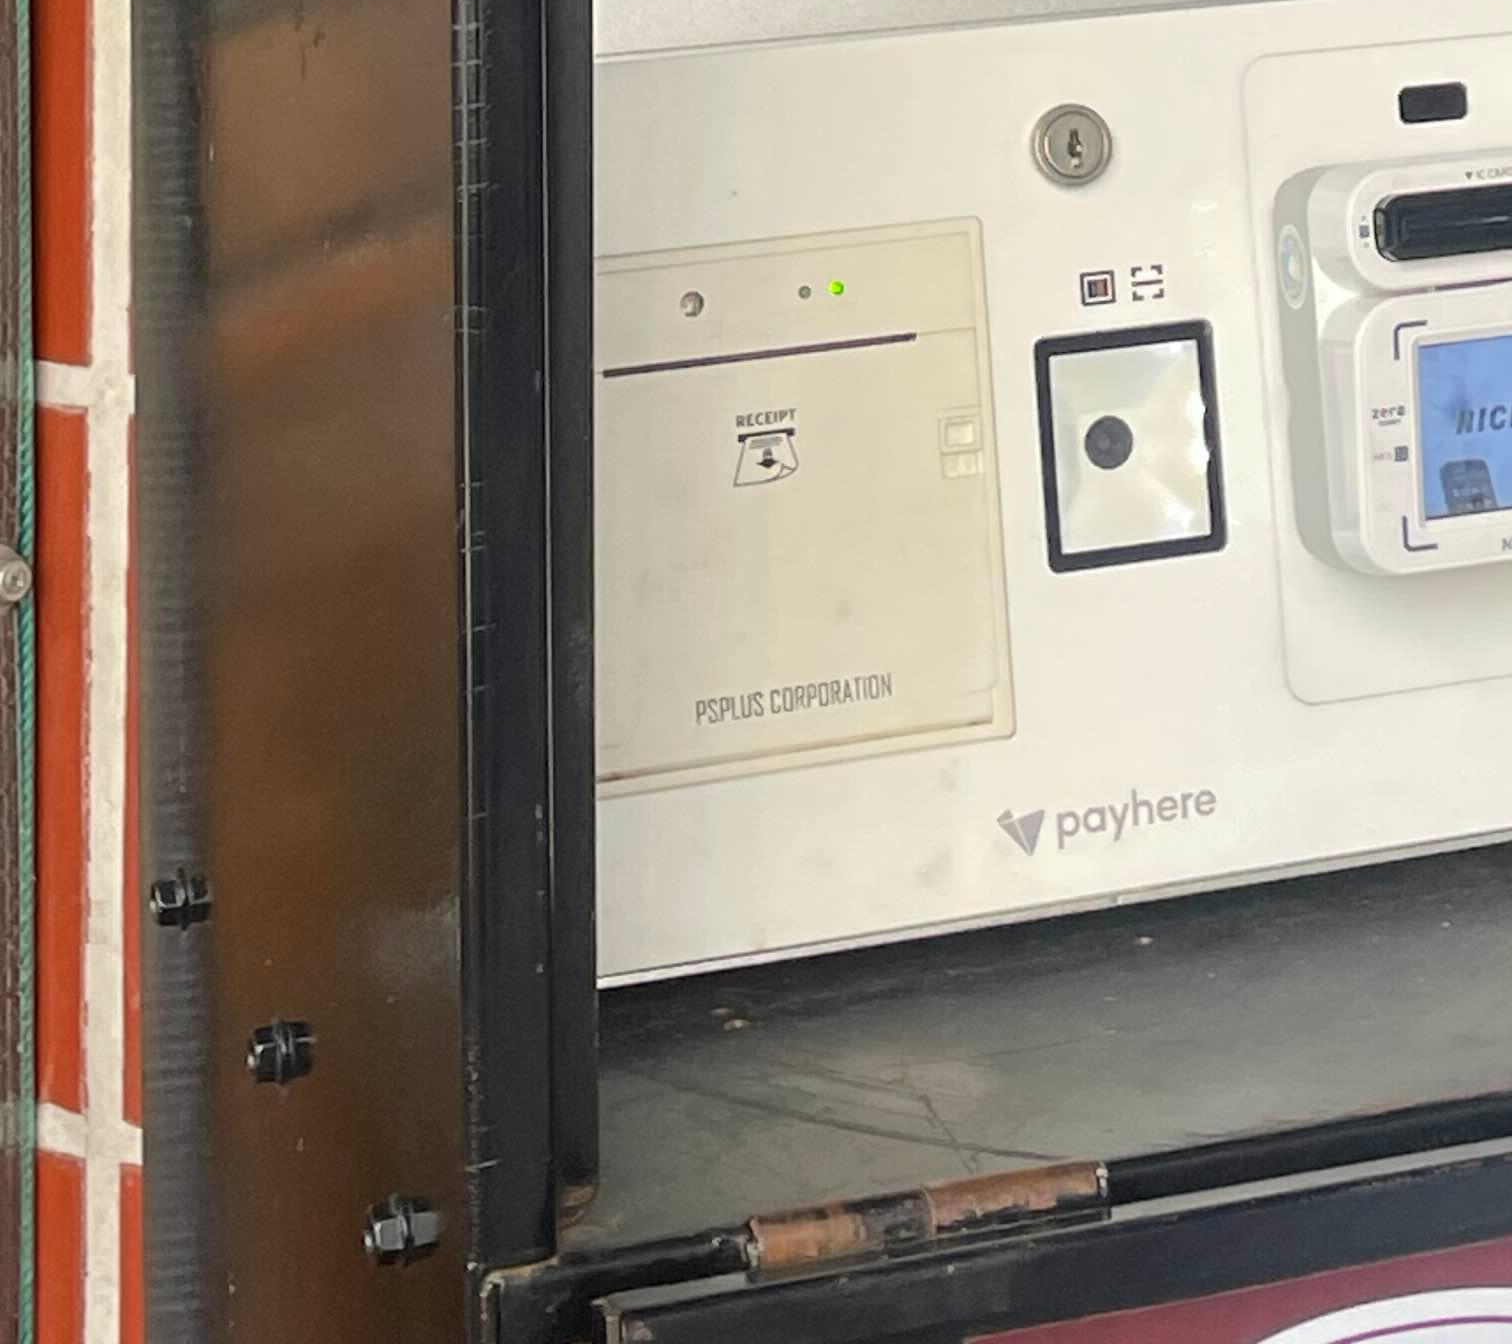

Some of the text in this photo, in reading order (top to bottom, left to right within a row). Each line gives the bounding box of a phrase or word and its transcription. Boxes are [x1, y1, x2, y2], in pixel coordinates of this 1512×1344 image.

[735, 408, 797, 429] RECEIPT
[694, 672, 893, 727] PSPLUS CORPORATION
[1055, 788, 1217, 851] payhere
